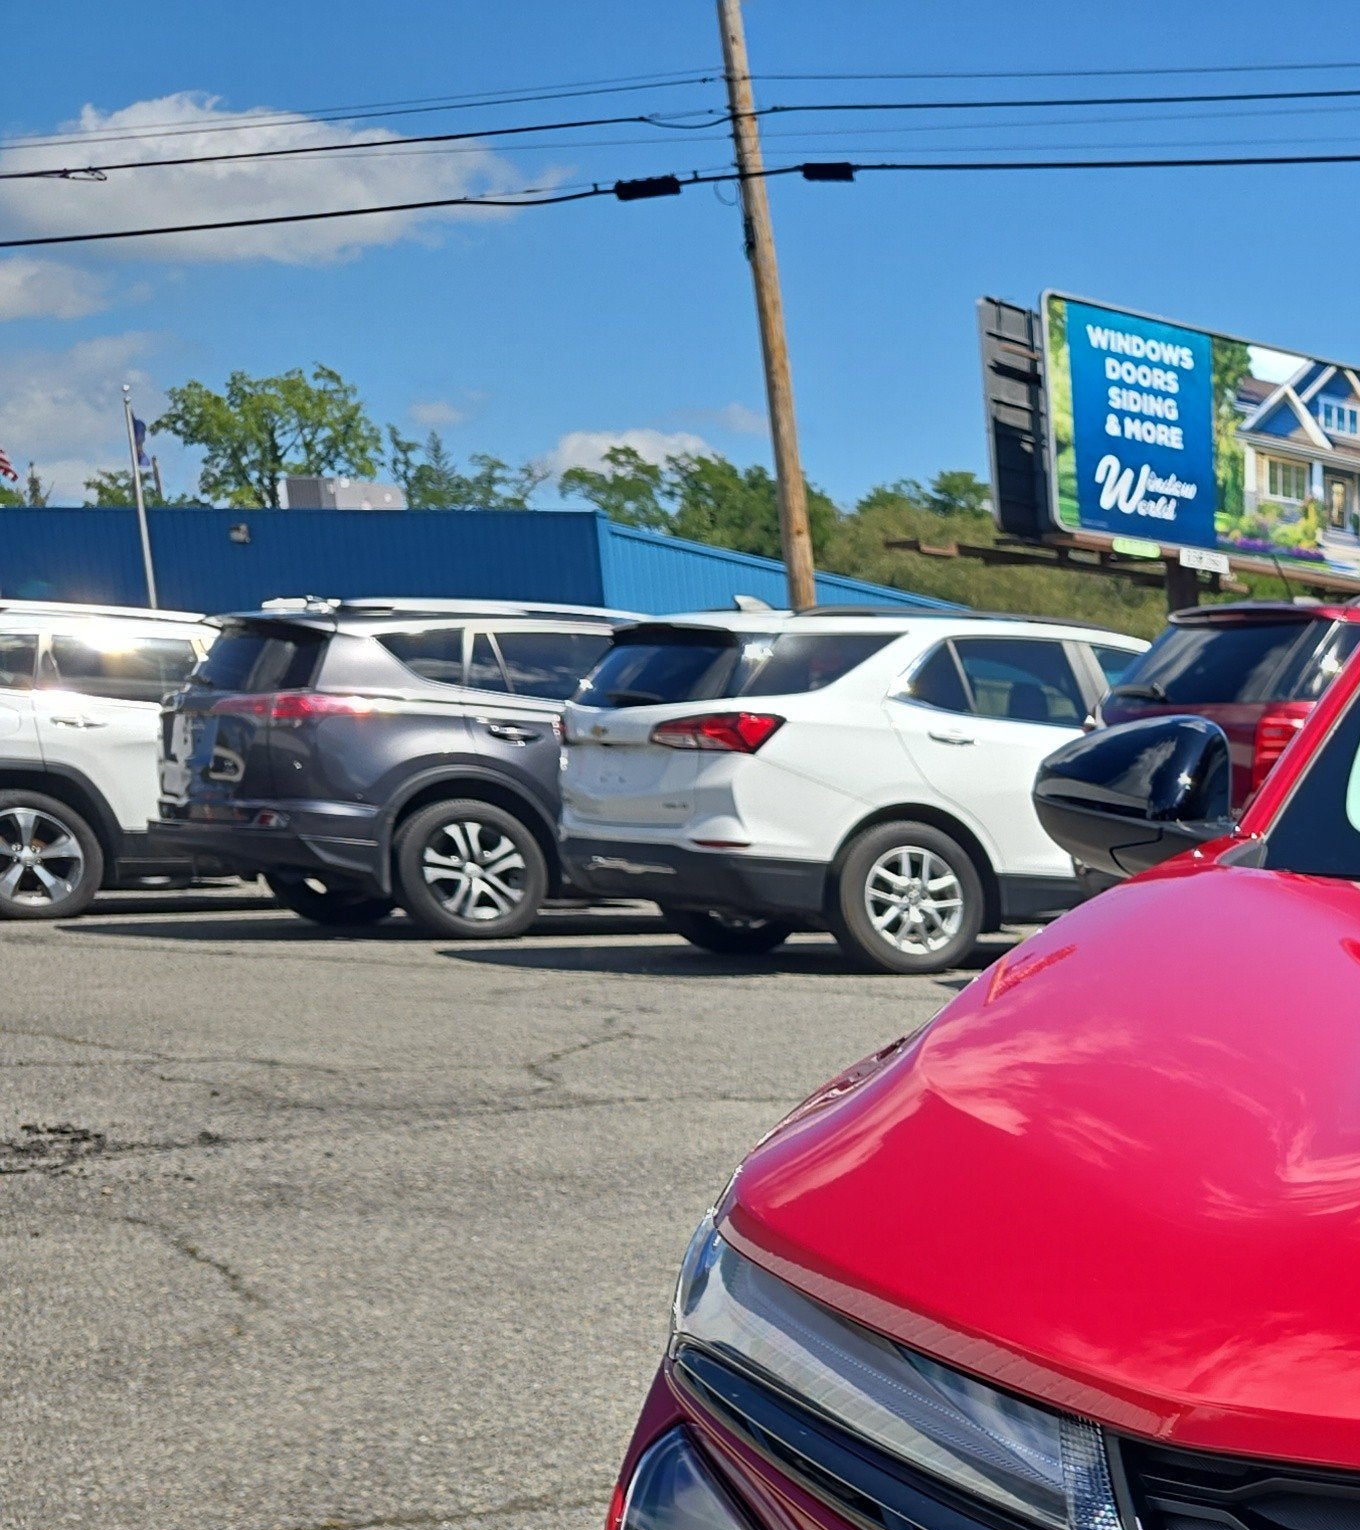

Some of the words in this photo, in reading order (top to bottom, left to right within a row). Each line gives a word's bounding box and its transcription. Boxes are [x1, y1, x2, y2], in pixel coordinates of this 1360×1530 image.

[1085, 324, 1195, 370] WINDOWS
[1105, 356, 1180, 394] DOORS
[1108, 385, 1179, 421] SIDING
[1105, 413, 1122, 437] &
[1123, 416, 1184, 450] MORE
[1094, 454, 1198, 515] Window
